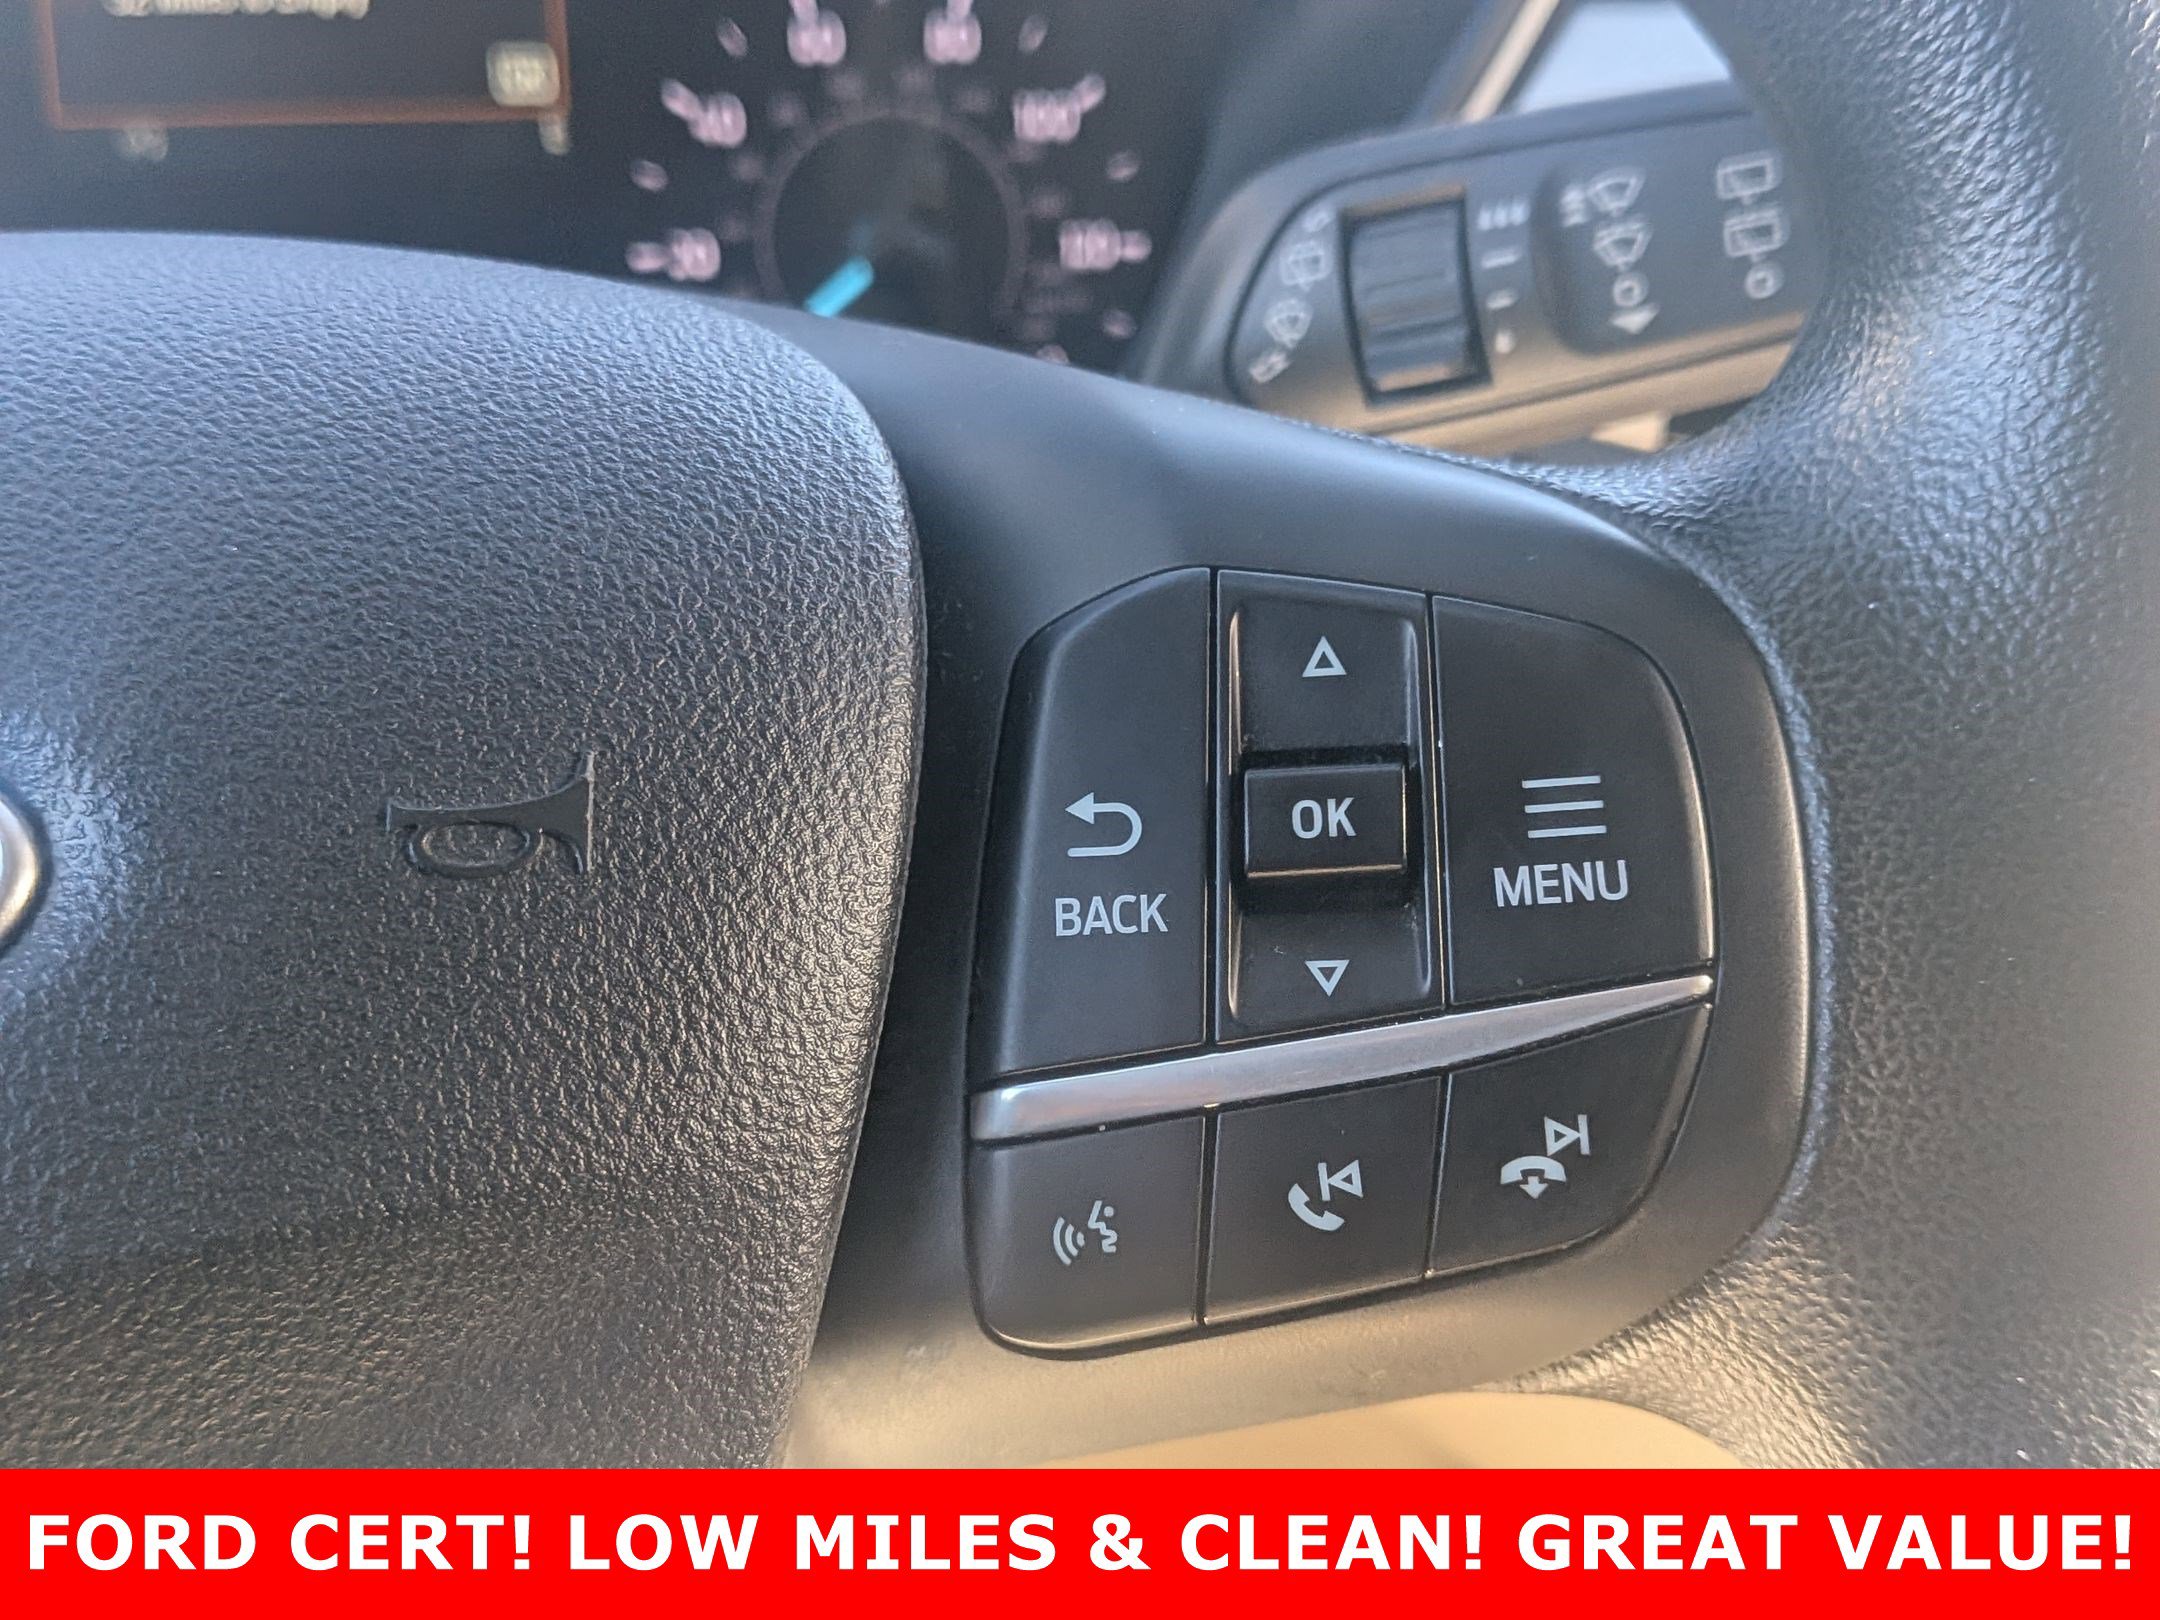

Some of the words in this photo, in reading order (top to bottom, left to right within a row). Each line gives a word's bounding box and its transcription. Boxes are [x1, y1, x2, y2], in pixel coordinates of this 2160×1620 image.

[1291, 796, 1357, 839] OK
[1493, 858, 1629, 908] MENU
[1054, 892, 1169, 938] BACK
